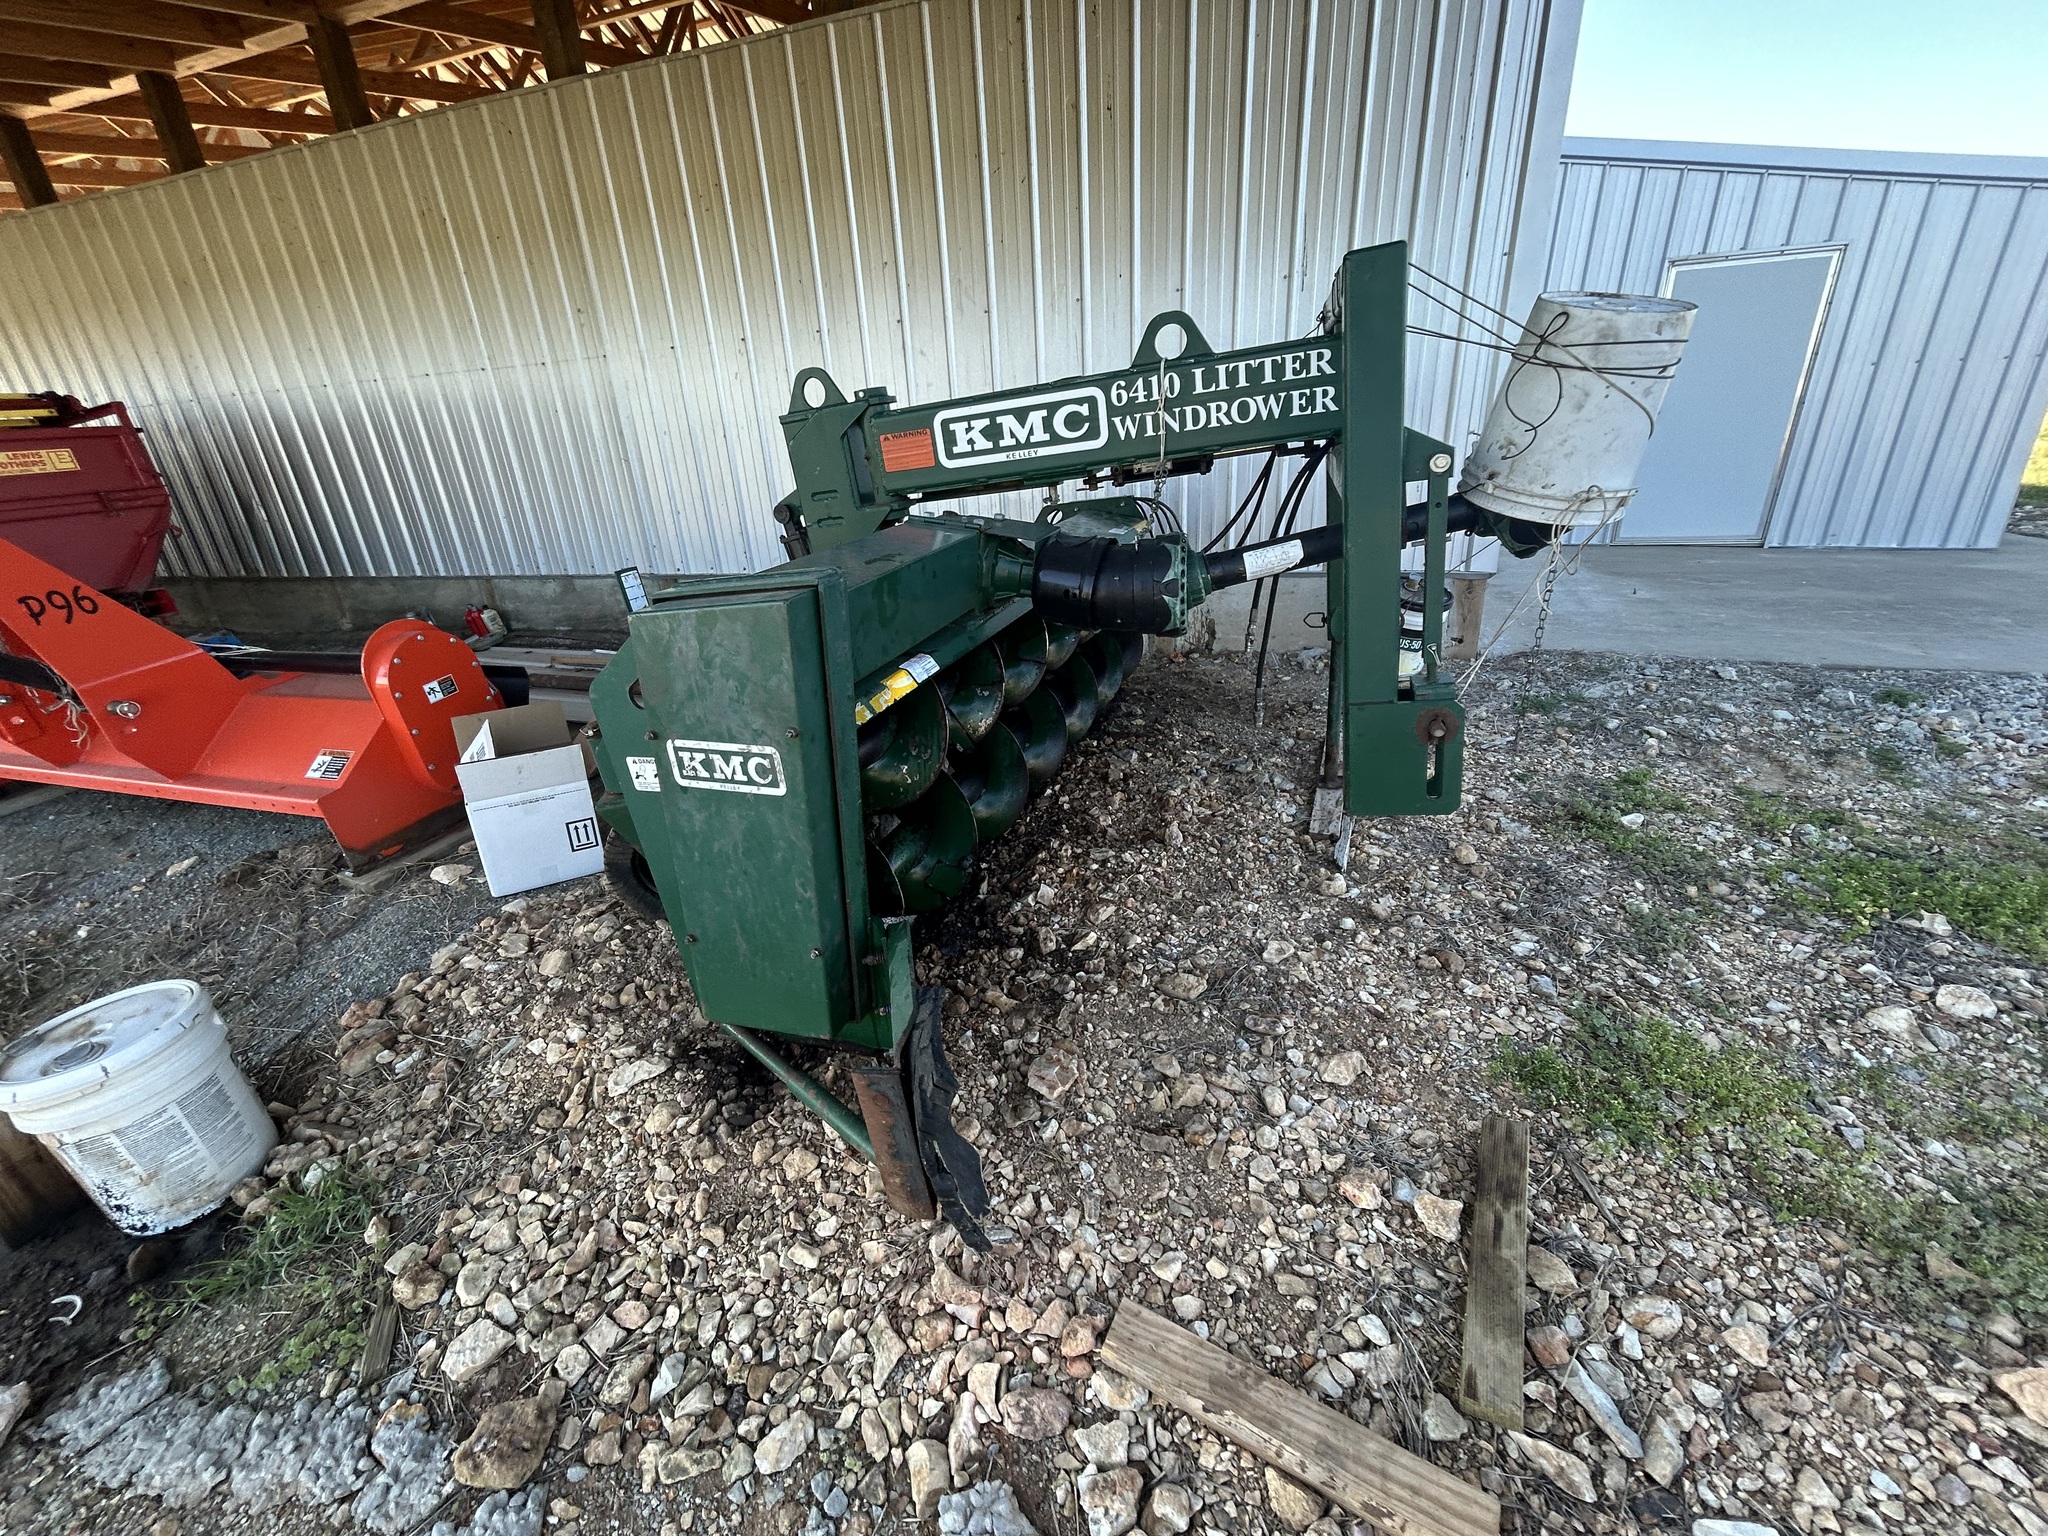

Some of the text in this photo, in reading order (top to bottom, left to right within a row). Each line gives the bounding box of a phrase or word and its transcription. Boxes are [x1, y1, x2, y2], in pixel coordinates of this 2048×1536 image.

[1111, 348, 1336, 407] 6410 LITTER
[949, 403, 1090, 454] KMC
[1111, 386, 1339, 441] WINDROWER
[891, 430, 928, 440] WARNING
[5, 452, 43, 460] LEWIS
[1006, 450, 1039, 460] KELLEY
[17, 586, 99, 626] P96
[678, 751, 773, 785] KMC
